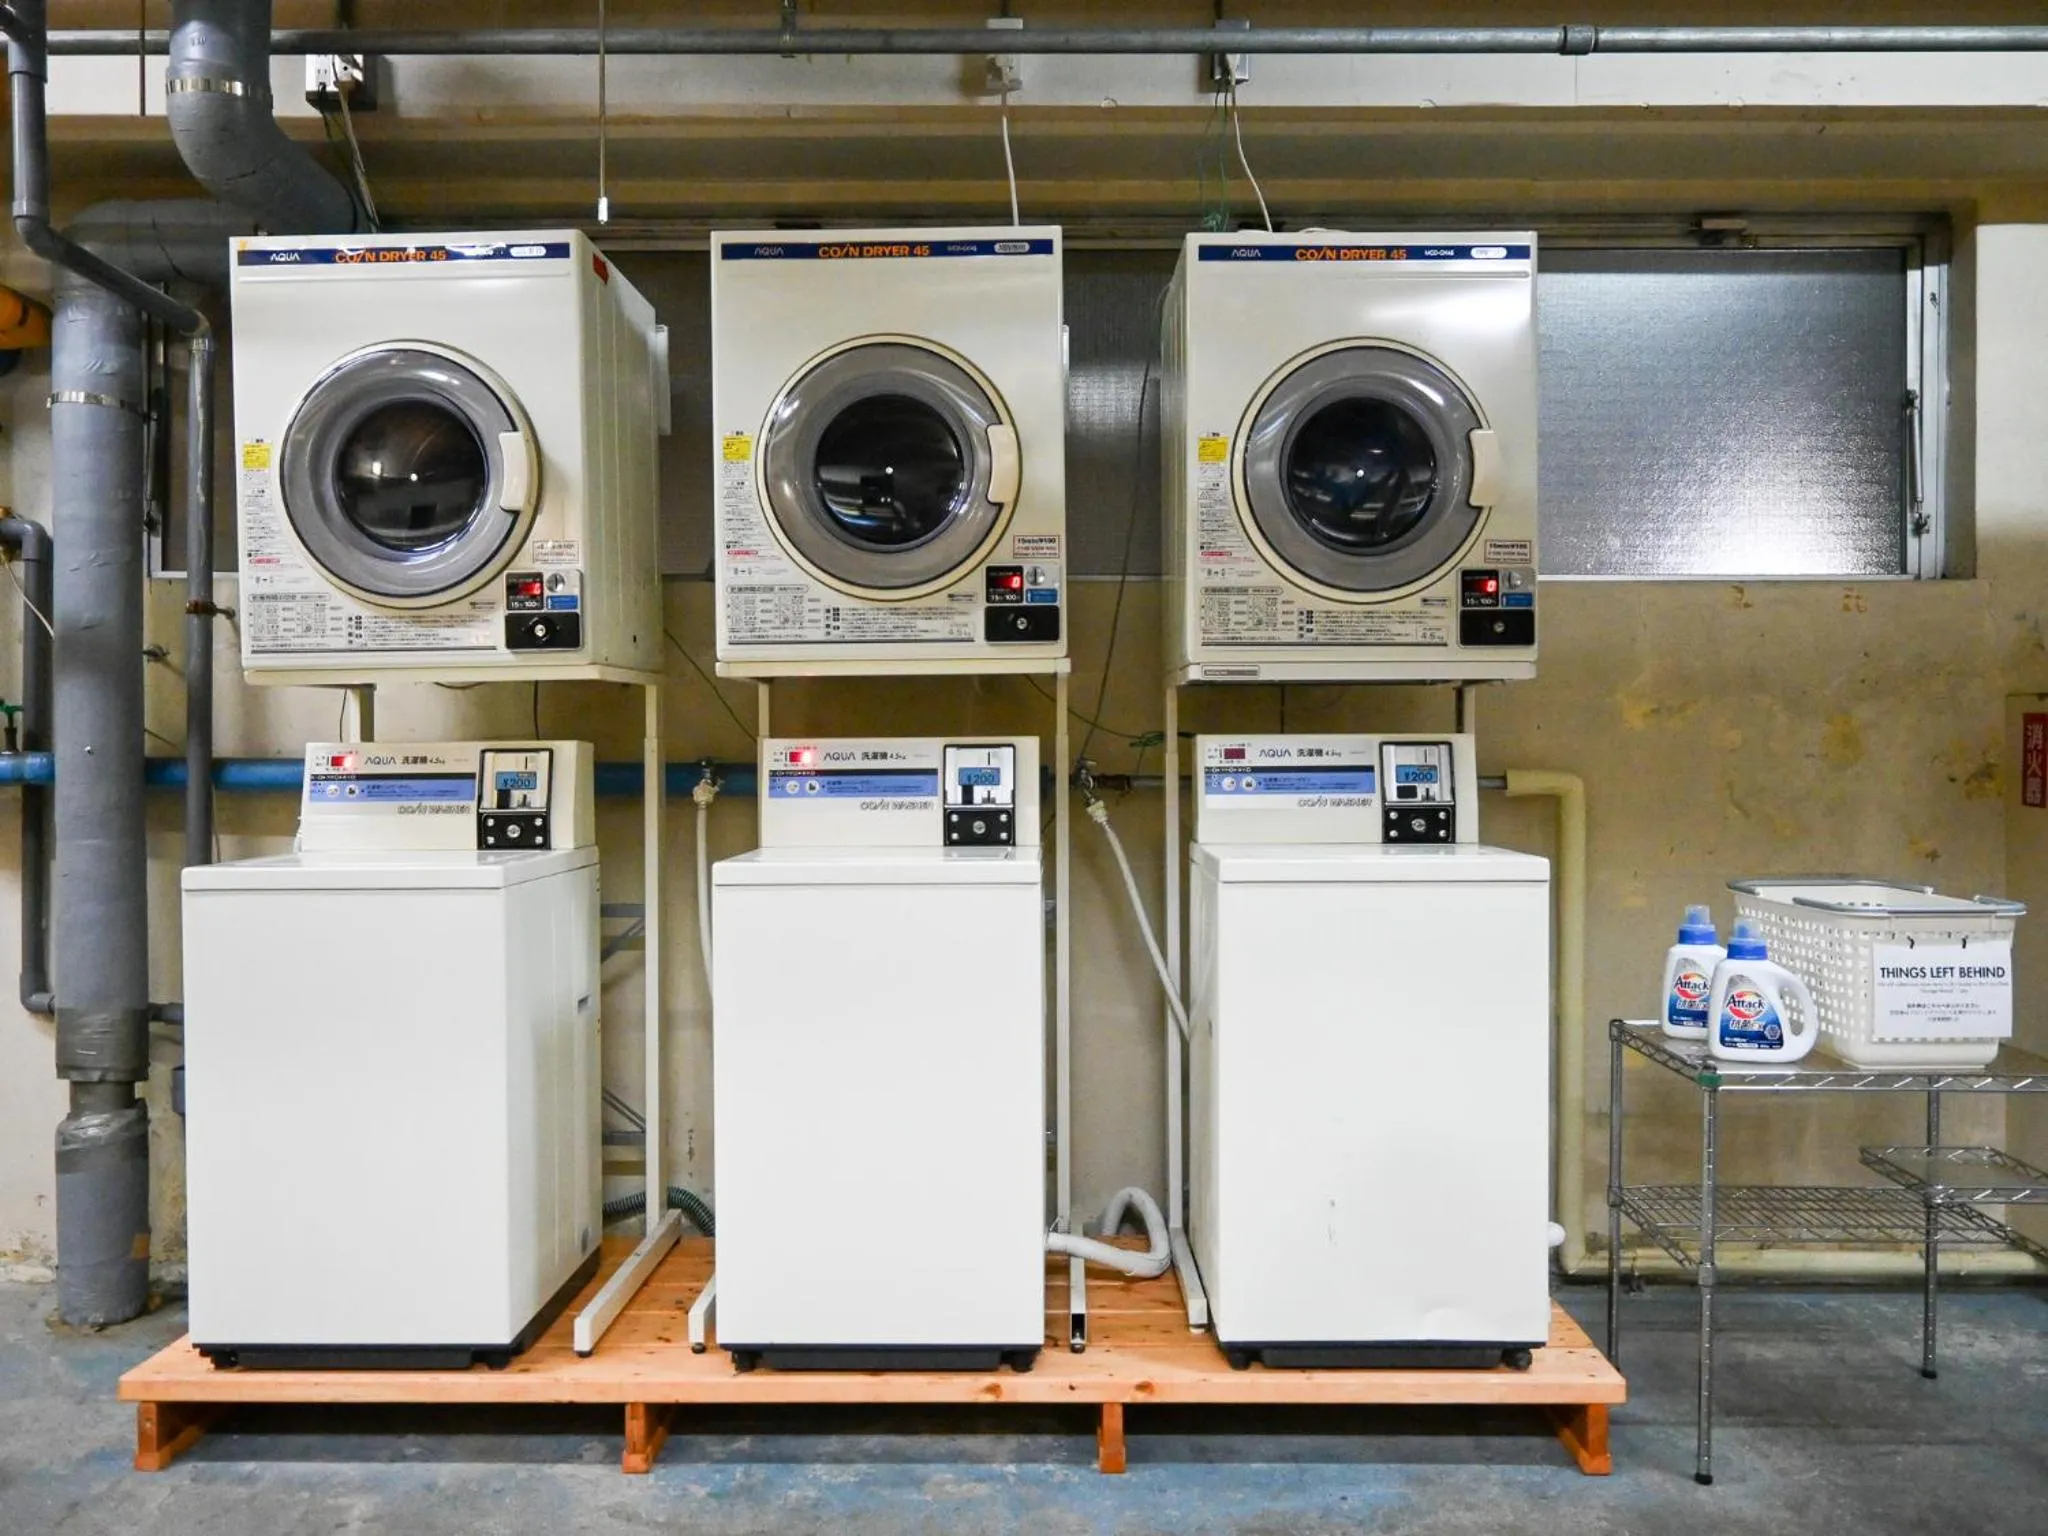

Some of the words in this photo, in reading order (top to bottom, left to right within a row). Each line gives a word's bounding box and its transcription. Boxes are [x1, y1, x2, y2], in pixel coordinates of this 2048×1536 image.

[379, 249, 426, 262] DRYER
[429, 250, 446, 261] 45
[753, 247, 785, 256] AQUA
[863, 245, 909, 257] DRYER
[913, 245, 930, 256] 45
[1231, 249, 1262, 258] AQUA
[1340, 249, 1386, 261] DRYER
[1390, 249, 1407, 260] 45
[270, 252, 300, 262] AQUA
[823, 751, 856, 762] AQUA
[1258, 748, 1292, 759] AQUA
[364, 756, 397, 766] AQUA
[1880, 966, 1927, 979] THINGS
[1930, 966, 1955, 979] LEFT
[1959, 966, 2005, 978] BEHIND
[1674, 975, 1709, 990] Attack
[1726, 994, 1765, 1009] Attack
